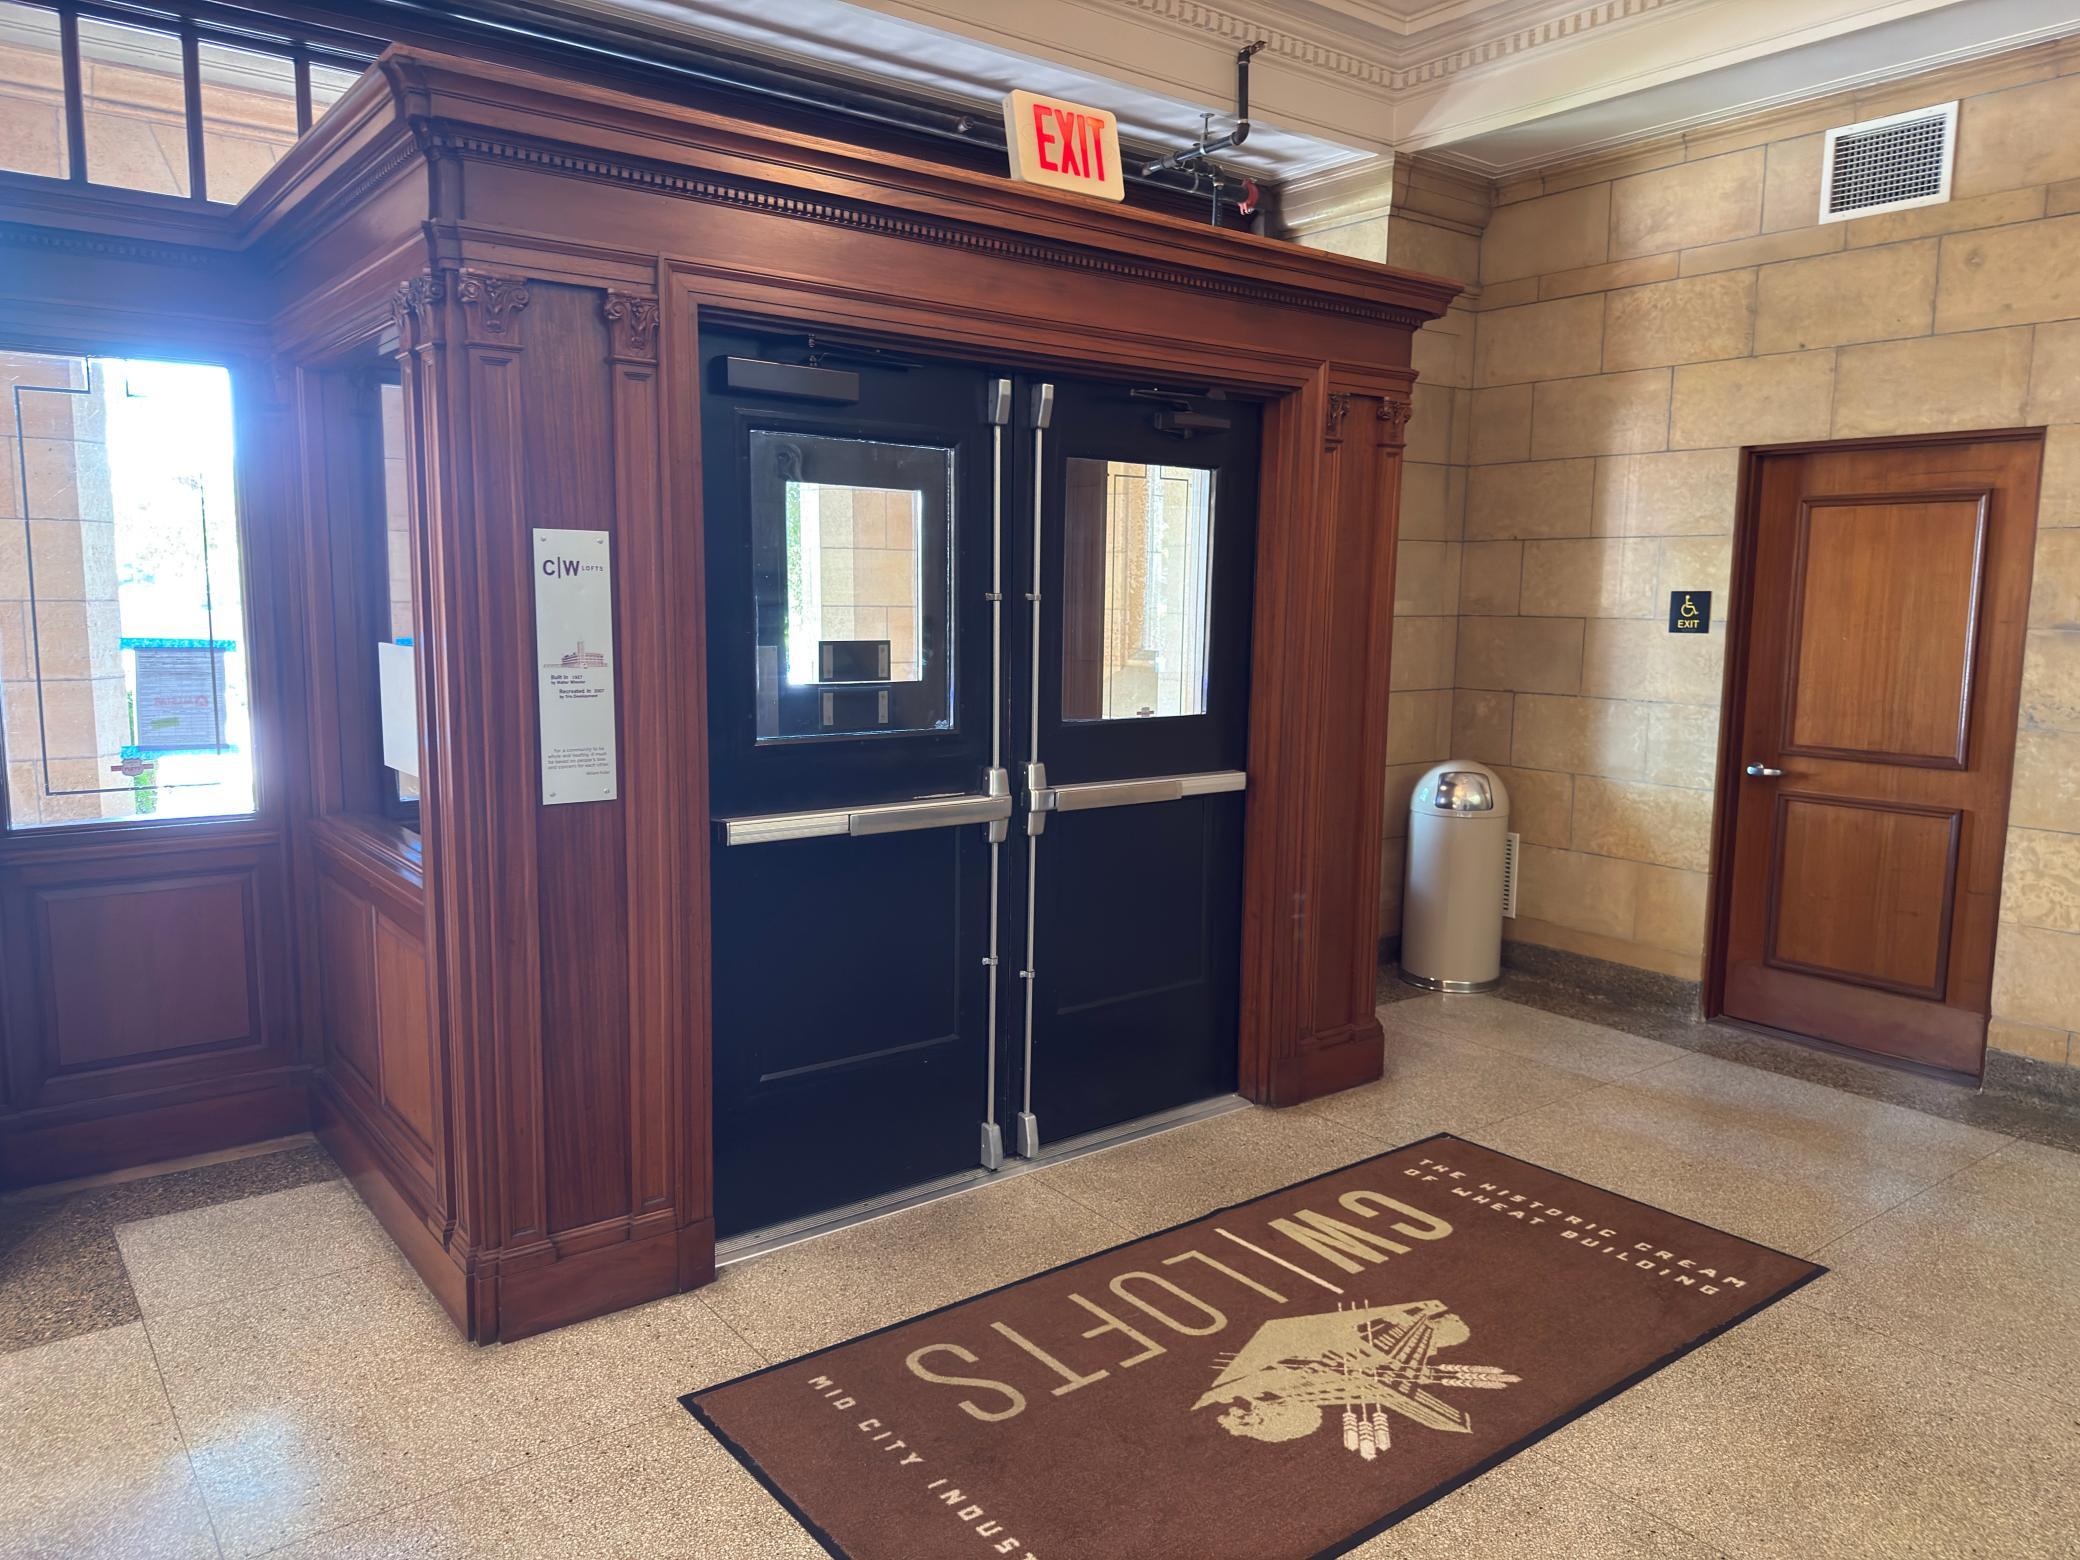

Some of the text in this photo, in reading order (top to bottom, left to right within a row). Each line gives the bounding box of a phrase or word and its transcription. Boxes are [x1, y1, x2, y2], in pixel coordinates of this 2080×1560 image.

[1033, 104, 1104, 181] EXIT
[1677, 619, 1700, 628] EXIT
[1403, 1168, 1719, 1295] OF WHEAT BUILDING
[1419, 1158, 1747, 1288] THE HISTORIC CREAM
[807, 1375, 857, 1410] MID
[857, 1418, 926, 1466] CITY
